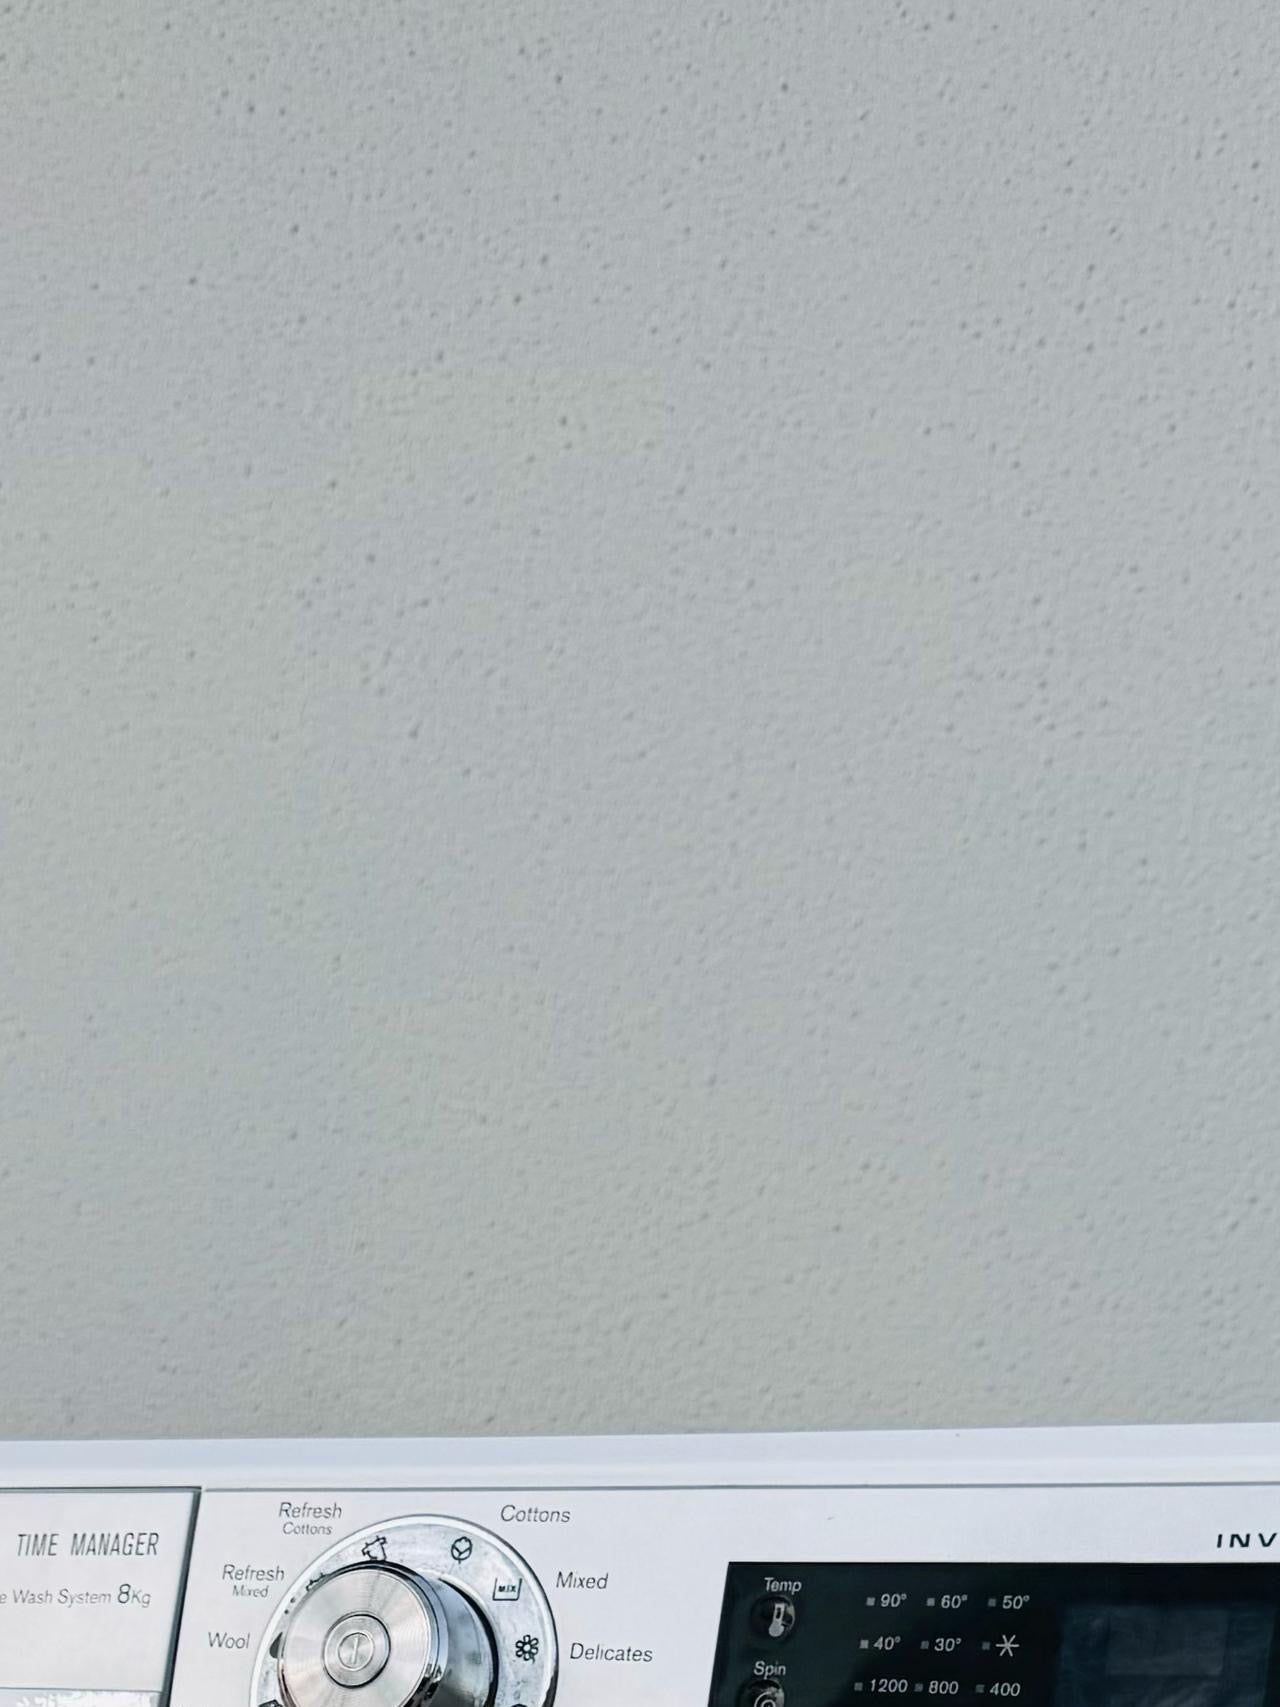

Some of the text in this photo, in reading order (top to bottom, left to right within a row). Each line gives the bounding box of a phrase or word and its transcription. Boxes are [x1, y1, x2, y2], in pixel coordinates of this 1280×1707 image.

[279, 1502, 342, 1518] Refresh
[500, 1505, 571, 1523] Cottons
[283, 1522, 333, 1535] Cottons
[18, 1533, 159, 1556] TIME MANAGER
[222, 1564, 284, 1581] Refresh
[556, 1572, 609, 1591] Mixed
[765, 1578, 802, 1594] Temp
[13, 1590, 53, 1604] Wash
[58, 1589, 111, 1607] System
[208, 1632, 250, 1650] Wool
[570, 1644, 653, 1663] Delicates
[754, 1661, 786, 1677] Spin
[870, 1679, 908, 1693] 1200
[929, 1680, 959, 1694] 800
[990, 1682, 1020, 1696] 400
